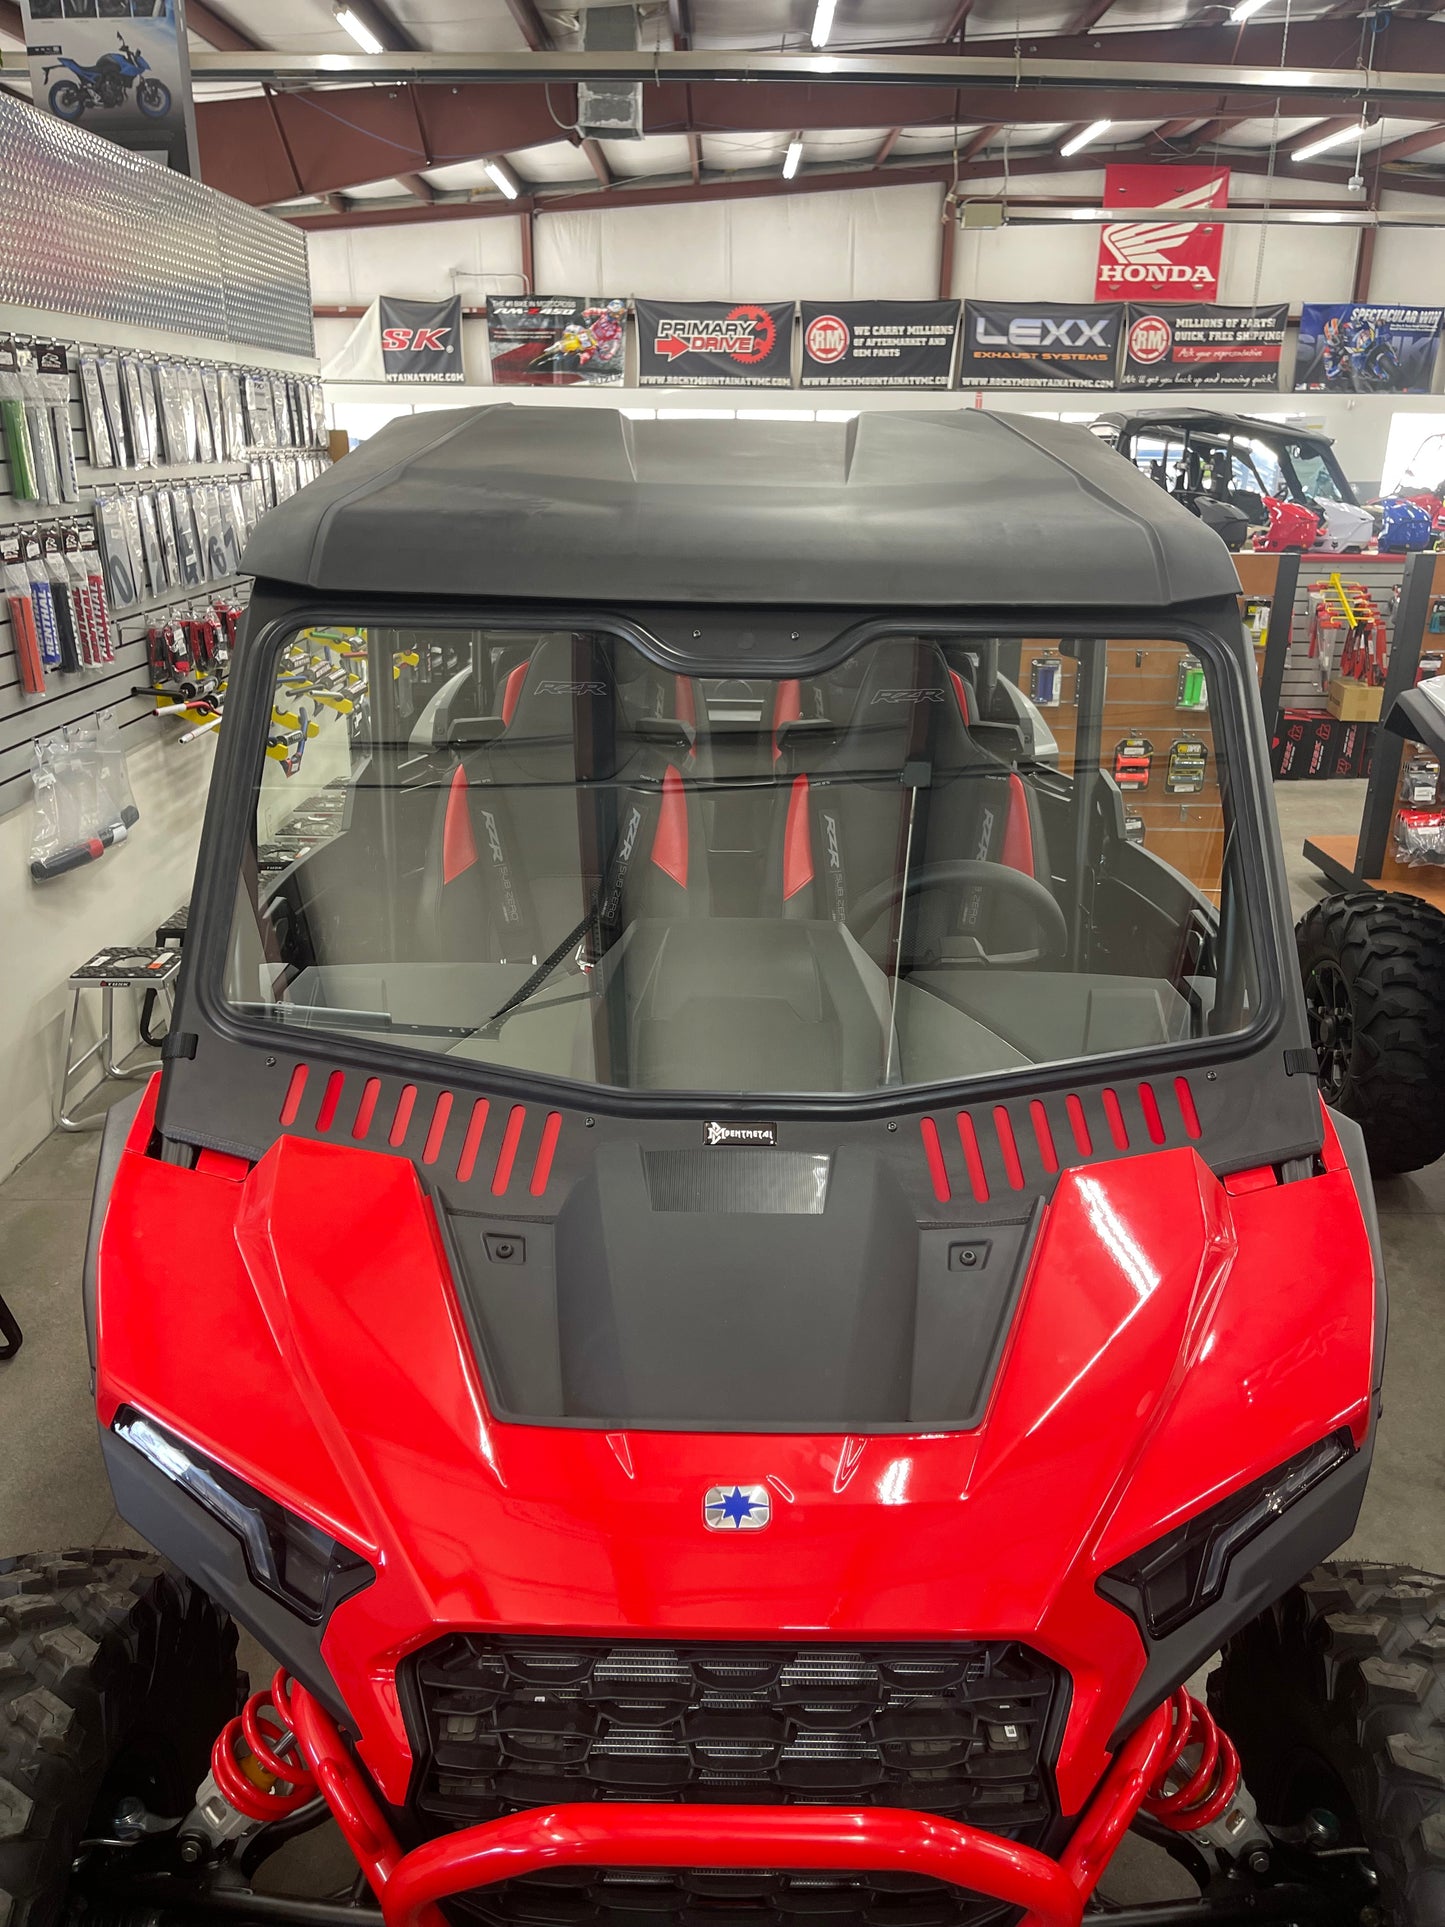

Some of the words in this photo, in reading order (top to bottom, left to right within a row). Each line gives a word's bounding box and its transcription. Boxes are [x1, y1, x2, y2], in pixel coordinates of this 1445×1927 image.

[1099, 265, 1216, 282] HONDA
[1175, 318, 1224, 328] MILLIONS
[1225, 318, 1238, 328] OF
[1240, 317, 1276, 328] PARTS!
[1350, 308, 1418, 323] SPECTACULAR
[1419, 310, 1442, 324] WIN
[658, 320, 757, 337] PRIMARY
[853, 326, 871, 335] WE
[872, 326, 905, 335] CARRY
[906, 325, 954, 335] MILLIONS
[976, 317, 1108, 346] LEXX
[1174, 331, 1206, 342] QUICK,
[1208, 331, 1234, 341] FREE
[1236, 331, 1285, 341] SHIPPING!
[690, 336, 754, 352] DRIVE
[815, 330, 840, 349] RM
[853, 338, 865, 346] OF
[865, 338, 927, 346] AFTERMARKET
[1135, 330, 1163, 348] RM
[853, 349, 871, 357] OEM
[873, 349, 900, 357] PARTS
[973, 351, 1038, 360] EXHAUST
[1041, 353, 1108, 361] SYSTEMS
[1178, 347, 1194, 357] Ask
[1193, 351, 1212, 361] your
[1213, 348, 1263, 360] representative
[640, 376, 791, 386] WWW.ROCKYMOUNTAINATVMC.COM
[962, 377, 1114, 388] WWW.ROCKYMOUNTAINATVMC.COM
[1145, 376, 1159, 387] get
[1158, 378, 1173, 387] you
[1174, 373, 1192, 383] back
[1193, 377, 1202, 387] up
[1204, 372, 1220, 383] and
[1220, 375, 1250, 387] running
[1252, 372, 1276, 387] quick!
[39, 590, 55, 656] RENTHAL
[534, 681, 607, 696] RZR
[871, 688, 945, 704] RZR
[1280, 741, 1293, 774] TUSK
[1309, 740, 1322, 774] TUSK
[480, 810, 503, 863] RZR
[619, 807, 641, 861] RZR
[823, 814, 840, 868] RZR
[499, 866, 512, 889] SUB
[616, 865, 627, 888] SUB
[505, 892, 519, 921] ZERO
[608, 889, 620, 919] ZERO
